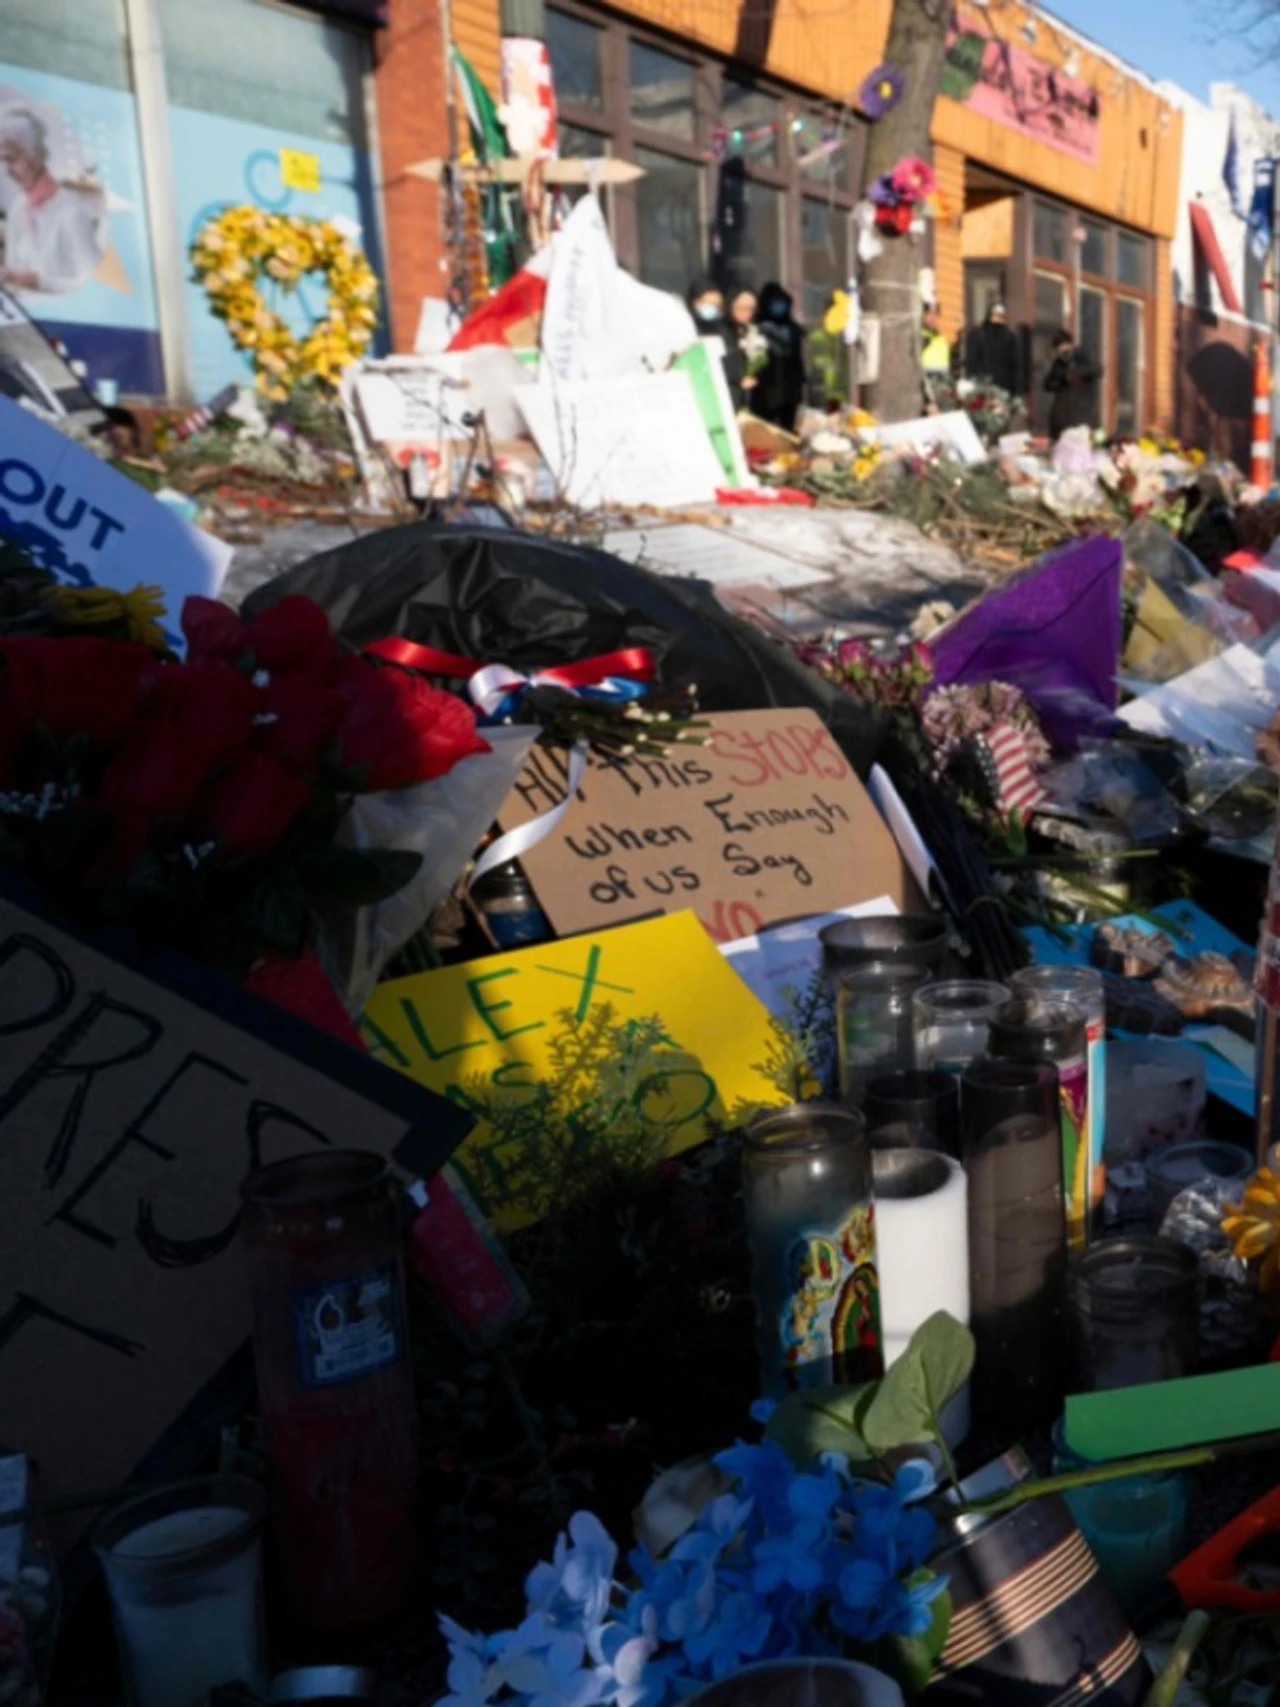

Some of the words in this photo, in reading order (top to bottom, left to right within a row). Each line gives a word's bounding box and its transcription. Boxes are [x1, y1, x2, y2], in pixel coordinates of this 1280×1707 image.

[0, 458, 125, 551] OUT
[564, 822, 694, 860] When
[704, 793, 850, 836] Enough
[721, 842, 814, 887] Say
